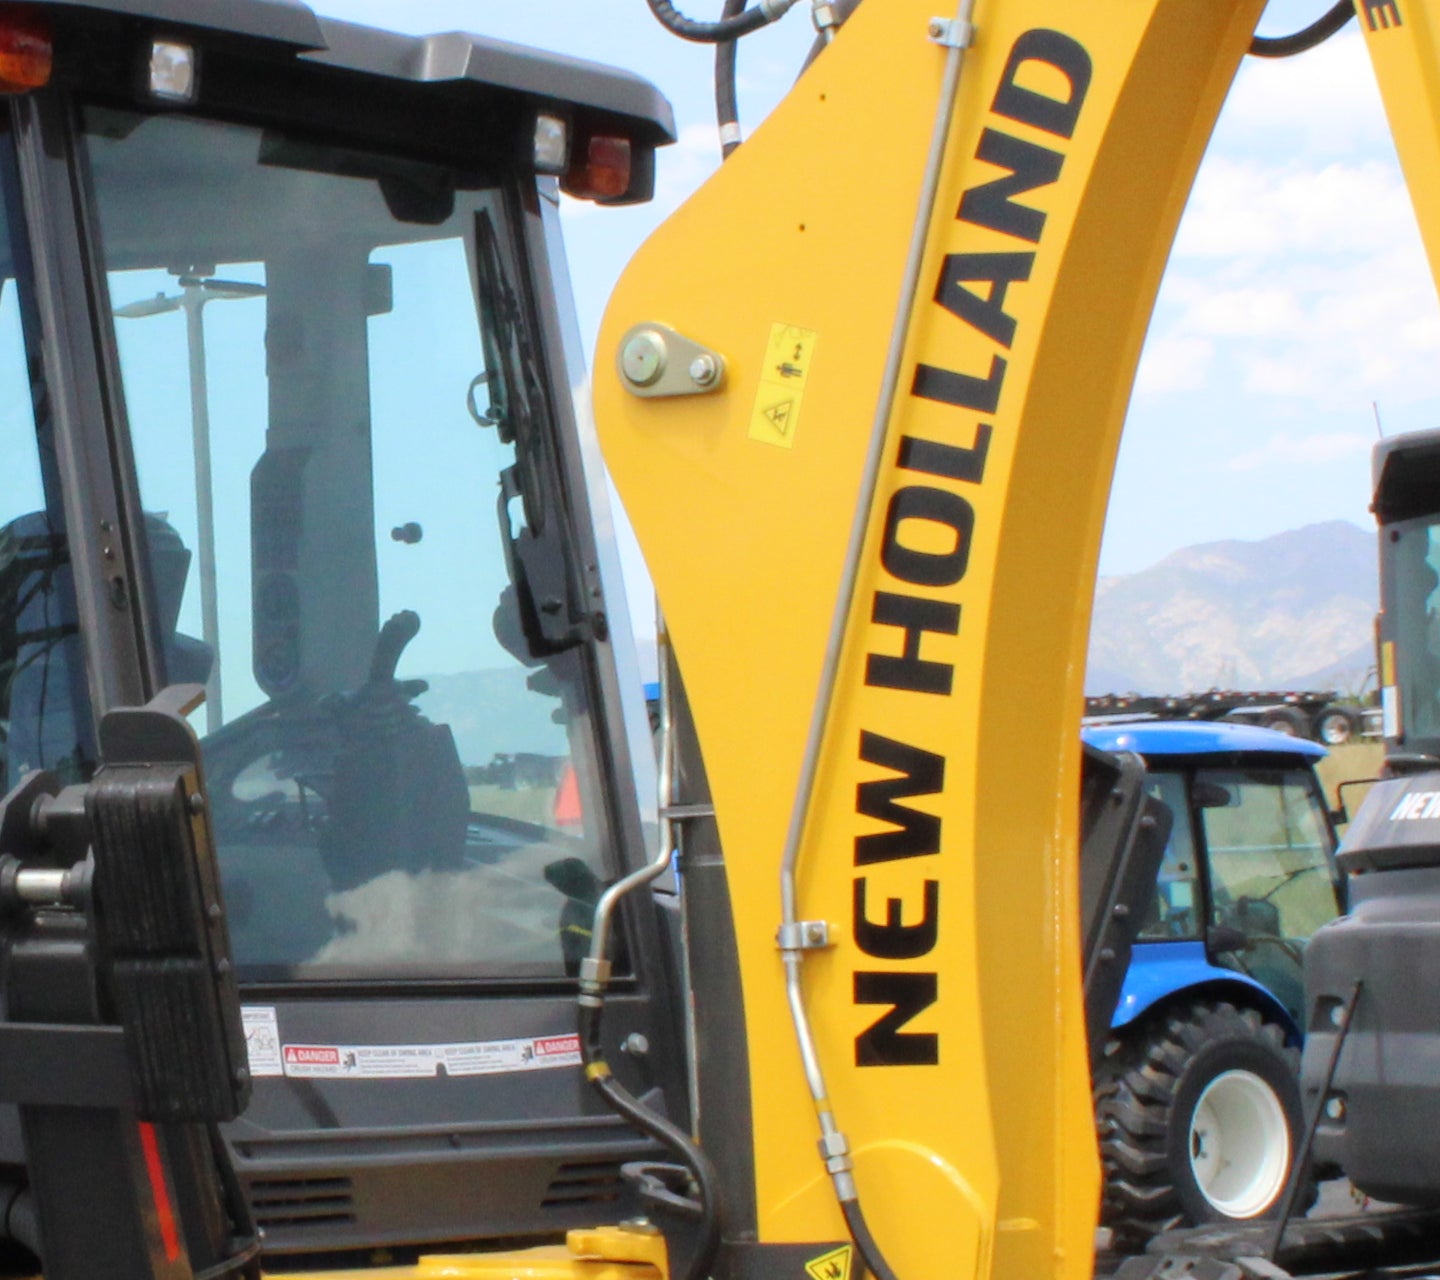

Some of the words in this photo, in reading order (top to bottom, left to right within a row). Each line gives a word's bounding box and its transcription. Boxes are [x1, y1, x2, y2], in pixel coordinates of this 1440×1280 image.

[864, 26, 1094, 697] HOLLAND
[297, 1049, 338, 1063] DANGER
[853, 728, 946, 1067] NEW
